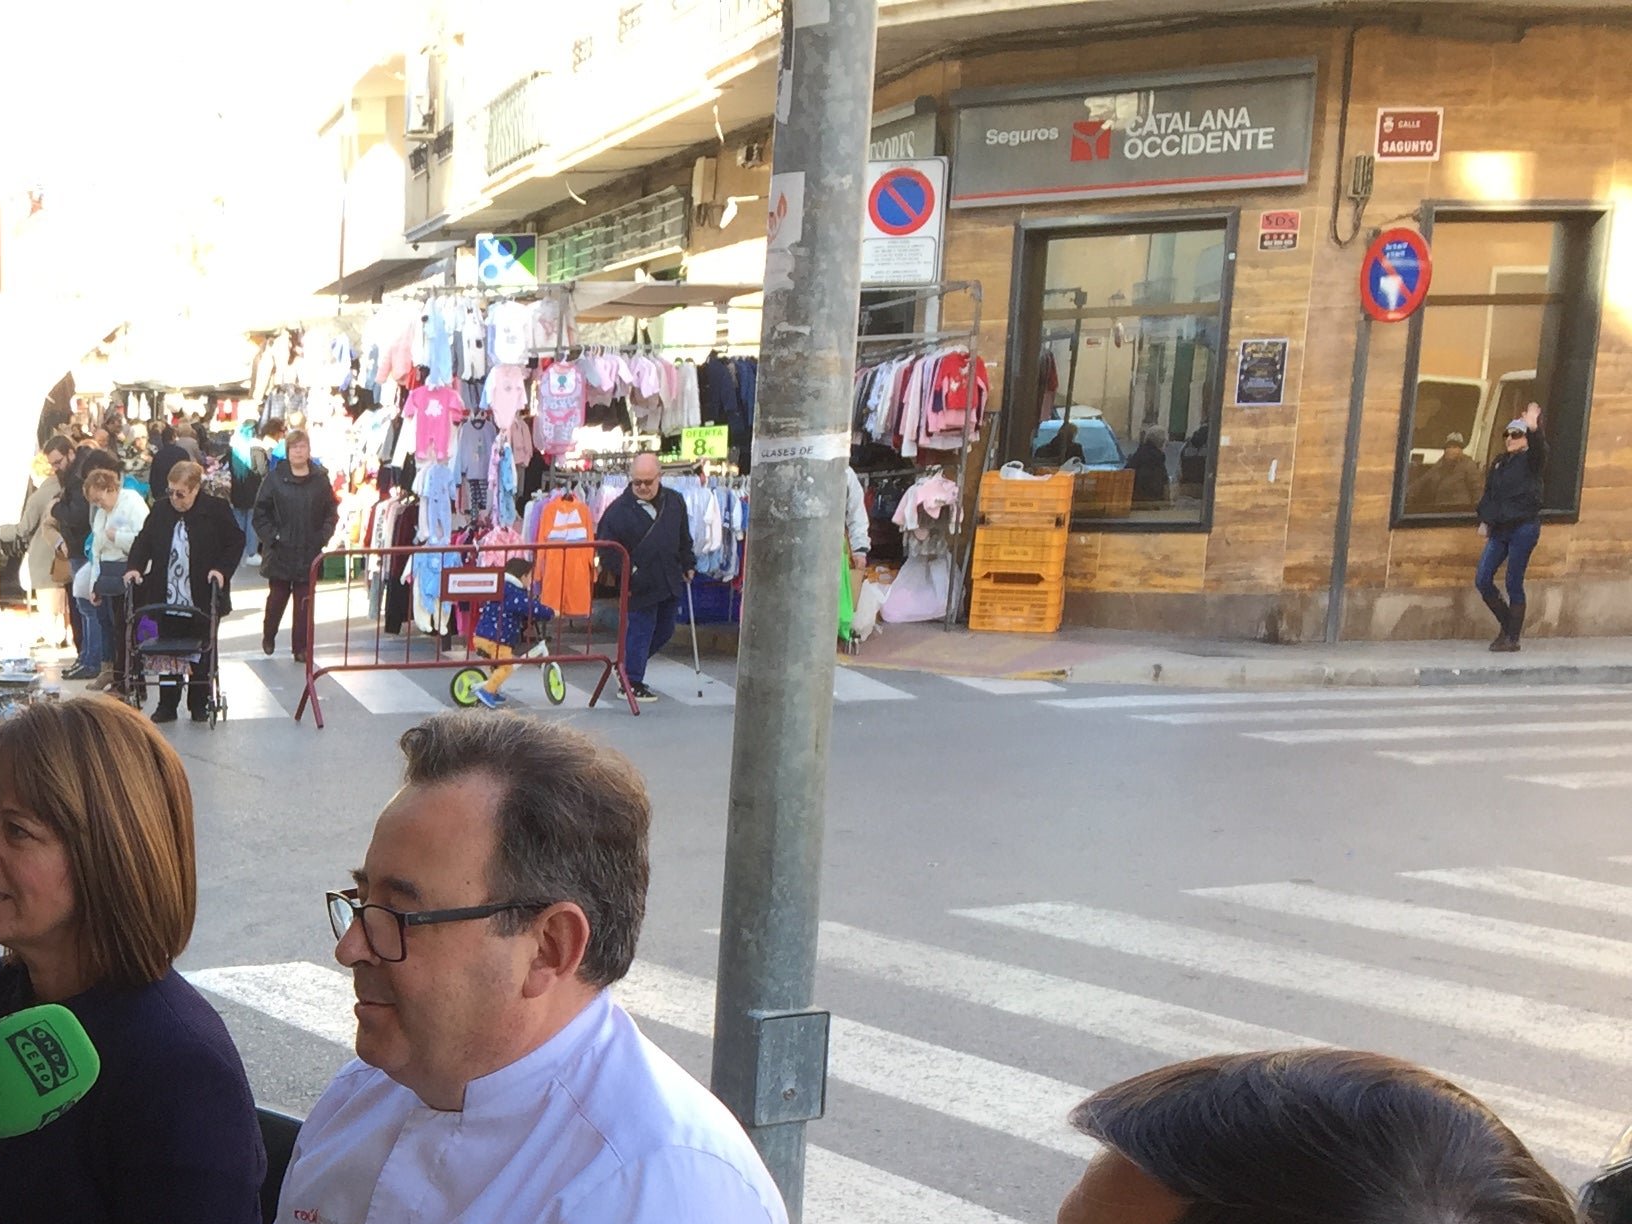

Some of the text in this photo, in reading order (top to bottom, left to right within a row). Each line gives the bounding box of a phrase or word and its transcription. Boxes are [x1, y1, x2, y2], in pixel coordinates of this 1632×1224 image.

[1124, 106, 1252, 137] CATALANA
[1397, 119, 1422, 129] CALLE
[985, 125, 1059, 147] Seguros
[1123, 127, 1275, 160] OCCIDENTE
[1382, 140, 1434, 153] SAGUNTO
[685, 428, 723, 438] OFERTA
[799, 445, 814, 456] DE
[21, 1041, 51, 1082] CERO
[35, 1030, 66, 1074] ONDA
